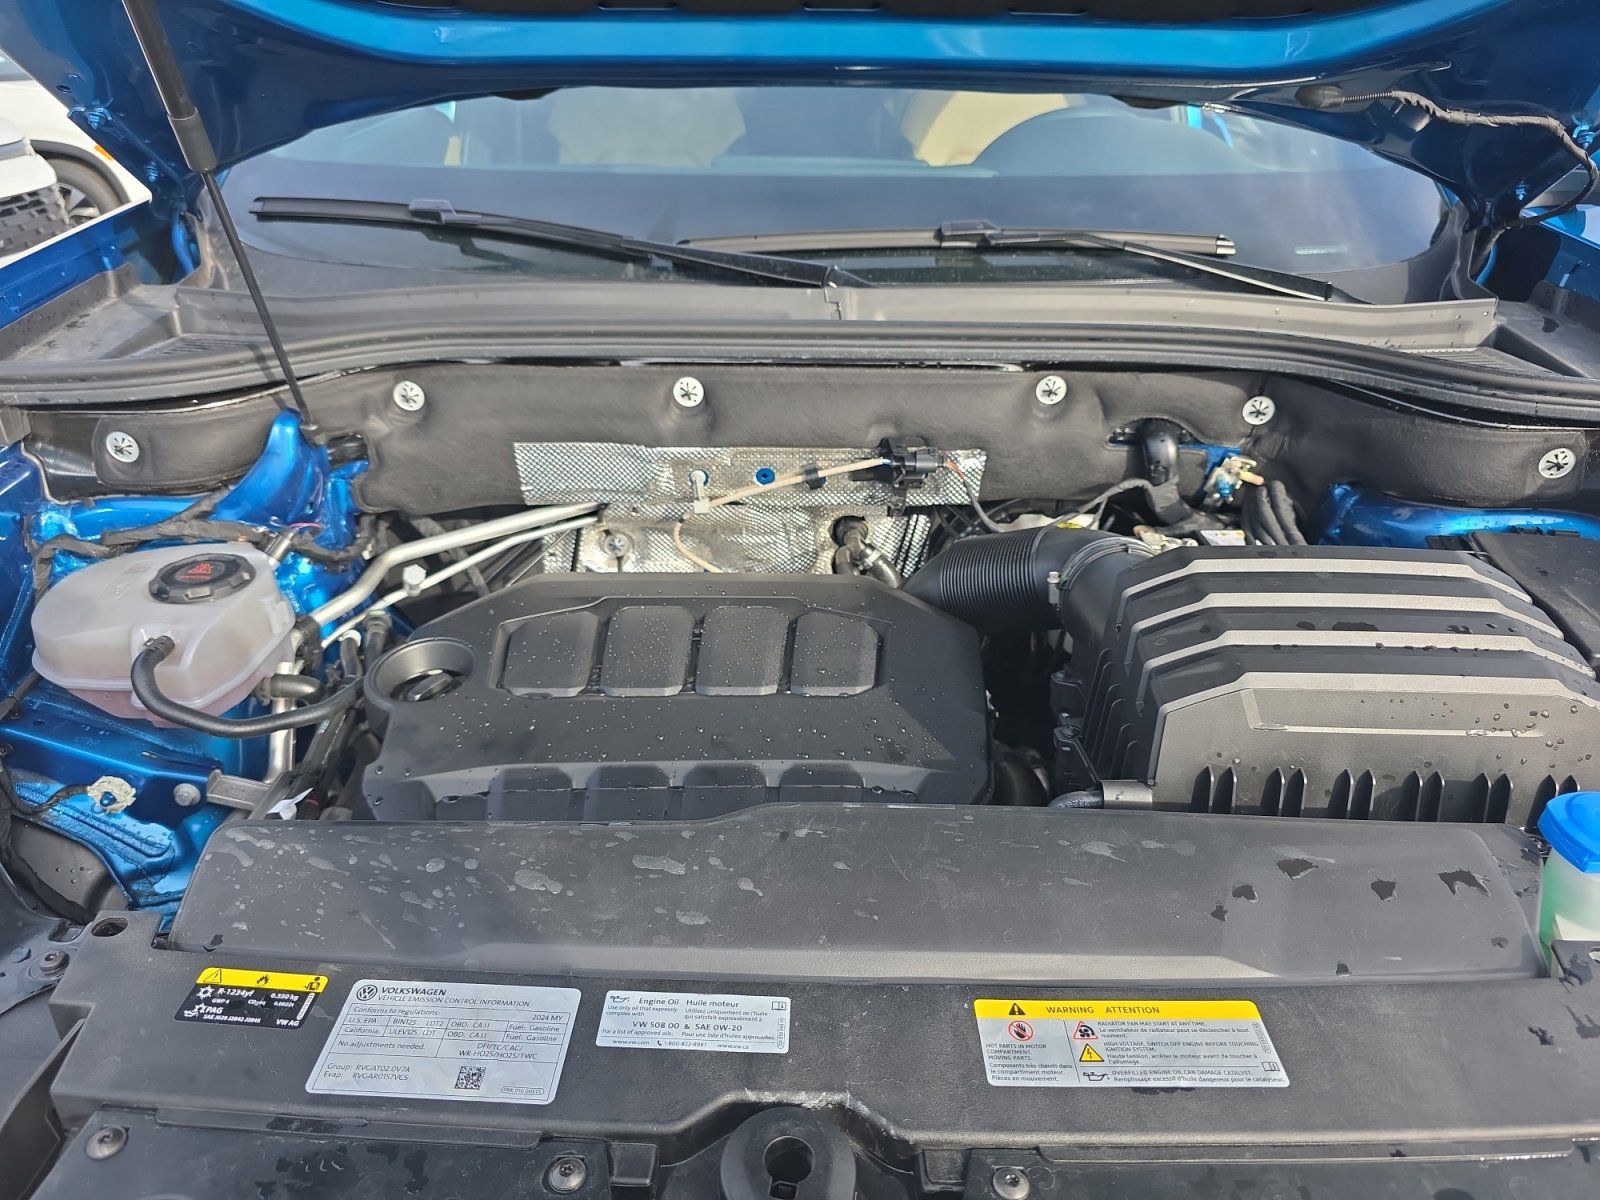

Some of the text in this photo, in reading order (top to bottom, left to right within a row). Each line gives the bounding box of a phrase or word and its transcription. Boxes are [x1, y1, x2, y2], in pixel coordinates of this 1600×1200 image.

[217, 988, 256, 998] R-1234yf
[381, 986, 447, 996] VOLKSWAGEN
[270, 992, 300, 1002] 0.550 kg
[378, 994, 406, 1002] VEHICLE
[444, 997, 477, 1005] CONTROL
[479, 999, 530, 1007] INFORMATION
[638, 997, 680, 1006] Engine Oil
[686, 999, 708, 1007] Huile
[206, 1006, 224, 1015] PAG
[353, 1006, 388, 1014] Conforms
[398, 1008, 441, 1016] regulations:
[1045, 1006, 1160, 1014] WARNING ATTENTION
[276, 1018, 300, 1027] VW AG
[392, 1018, 417, 1026] BIN125
[632, 1020, 648, 1028] VW
[650, 1021, 666, 1029] 508
[694, 1023, 711, 1031] SAE
[713, 1024, 743, 1032] 0W-20
[344, 1026, 381, 1034] California:
[508, 1023, 560, 1032] Fuel: Gasoline
[505, 1033, 558, 1042] Fuel: Gasoline
[349, 1041, 395, 1049] adjustments
[396, 1042, 426, 1050] needed.
[476, 1042, 524, 1052] DFI/TC/CAC/
[327, 1062, 353, 1072] Group:
[323, 1070, 344, 1079] Evap:
